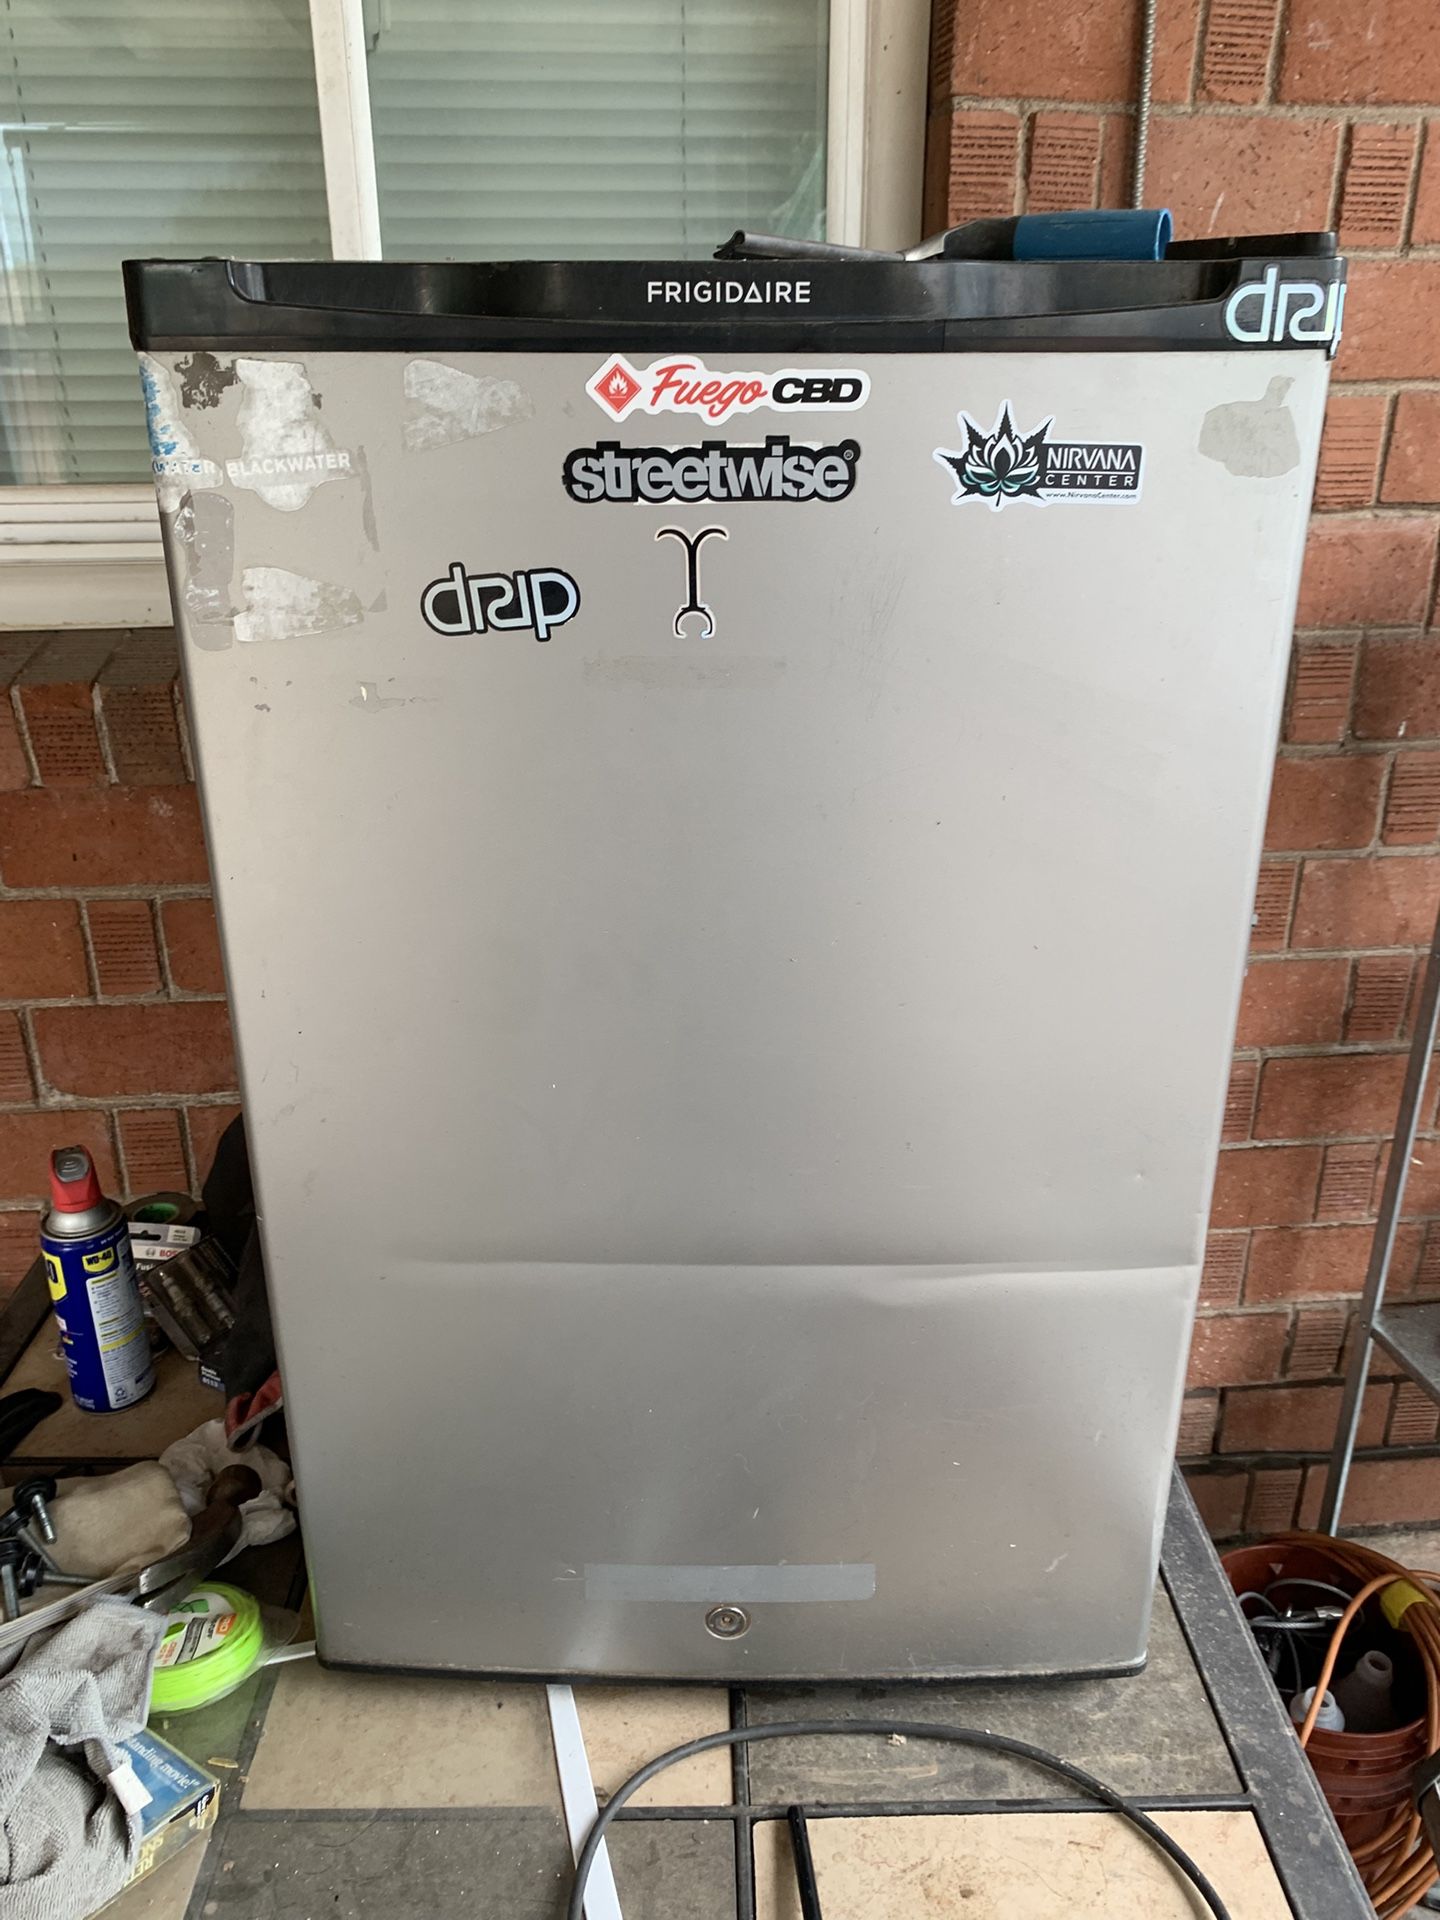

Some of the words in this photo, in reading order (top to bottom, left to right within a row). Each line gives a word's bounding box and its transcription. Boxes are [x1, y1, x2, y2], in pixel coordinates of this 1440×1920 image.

[647, 281, 811, 303] FRIGIDAIRE
[650, 364, 768, 417] Fuego
[772, 377, 863, 404] CBD
[225, 452, 351, 477] BLACKWATER
[1046, 447, 1136, 470] NIRVANA
[1045, 474, 1134, 487] CENTER
[1045, 491, 1137, 499] www.NirvanaCenter.com
[423, 565, 578, 639] drip
